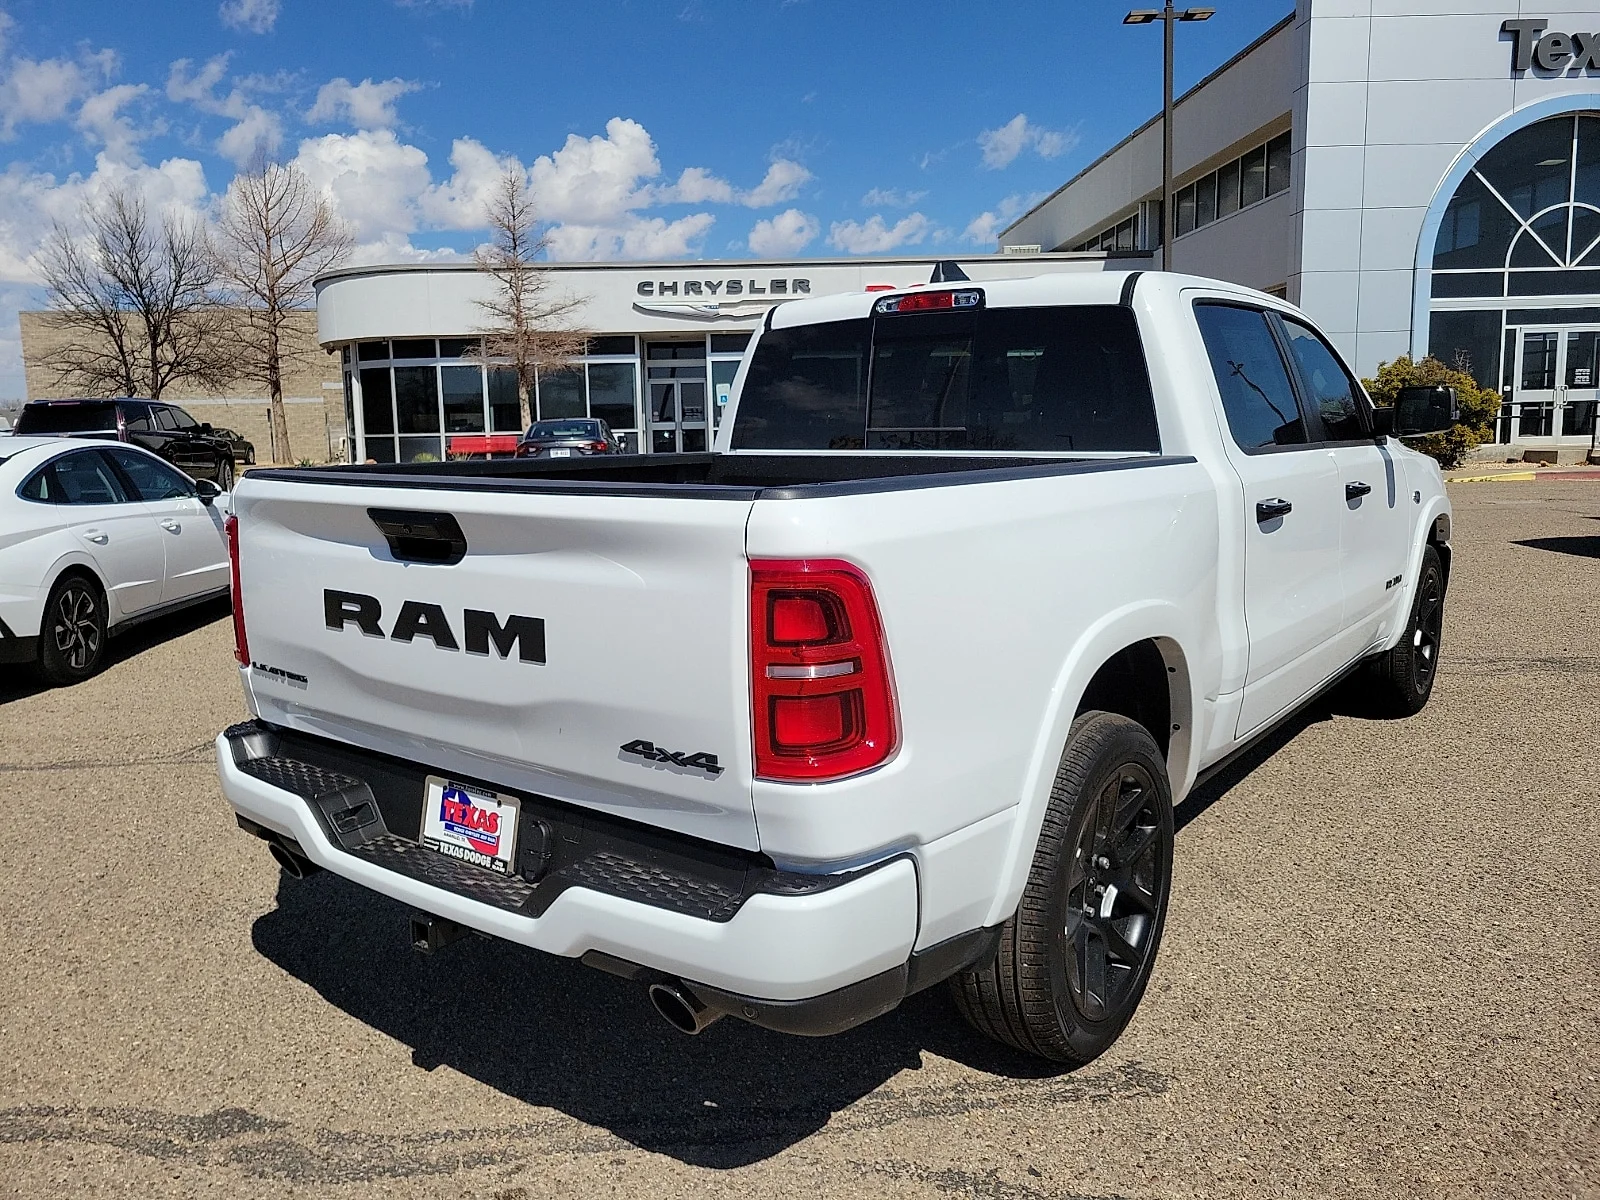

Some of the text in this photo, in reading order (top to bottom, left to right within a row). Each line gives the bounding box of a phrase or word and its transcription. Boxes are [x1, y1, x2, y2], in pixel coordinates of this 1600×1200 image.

[637, 279, 811, 296] CHRYSLER
[323, 588, 547, 666] RAM
[443, 799, 499, 834] TEXAS
[440, 842, 463, 858] TEXAS
[464, 850, 491, 867] DODGE
